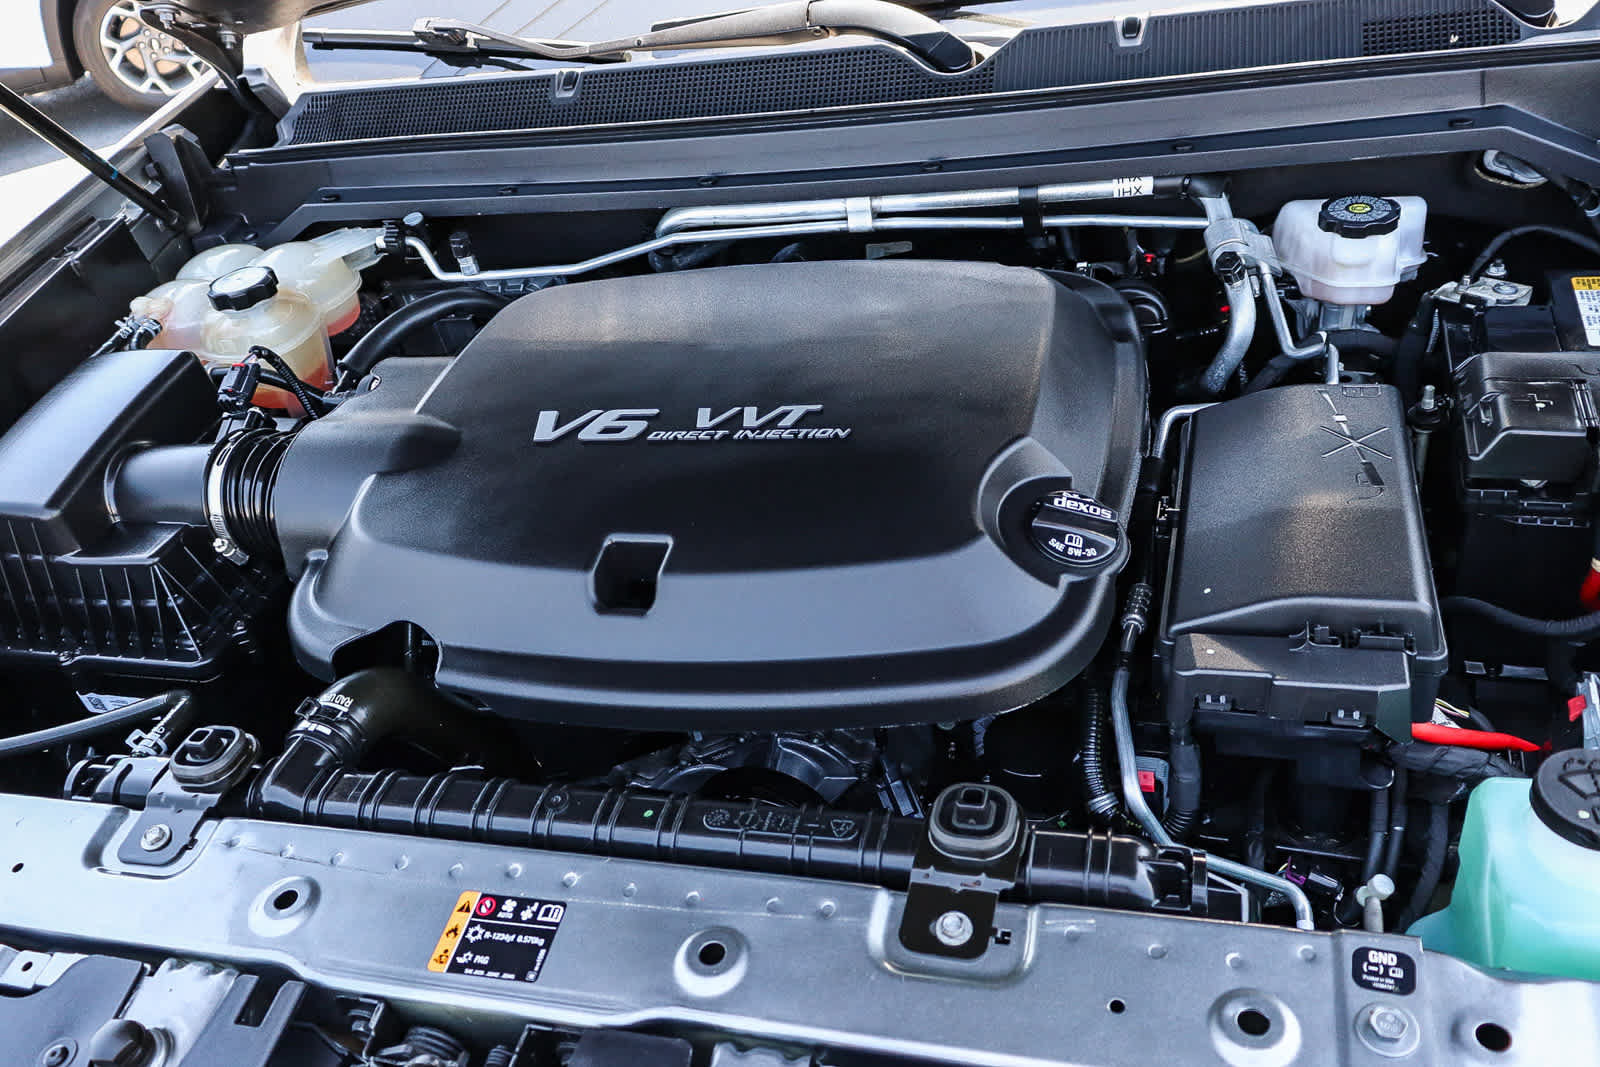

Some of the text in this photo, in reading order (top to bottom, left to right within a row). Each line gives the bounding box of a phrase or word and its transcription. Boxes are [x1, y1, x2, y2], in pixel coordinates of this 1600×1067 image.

[1118, 186, 1143, 197] IHX
[533, 404, 824, 442] V6 VVT
[646, 427, 852, 441] DIRECT INJECTION
[1053, 496, 1112, 519] dexos
[1048, 538, 1097, 557] SAE 5W-30
[1368, 950, 1398, 967] GND
